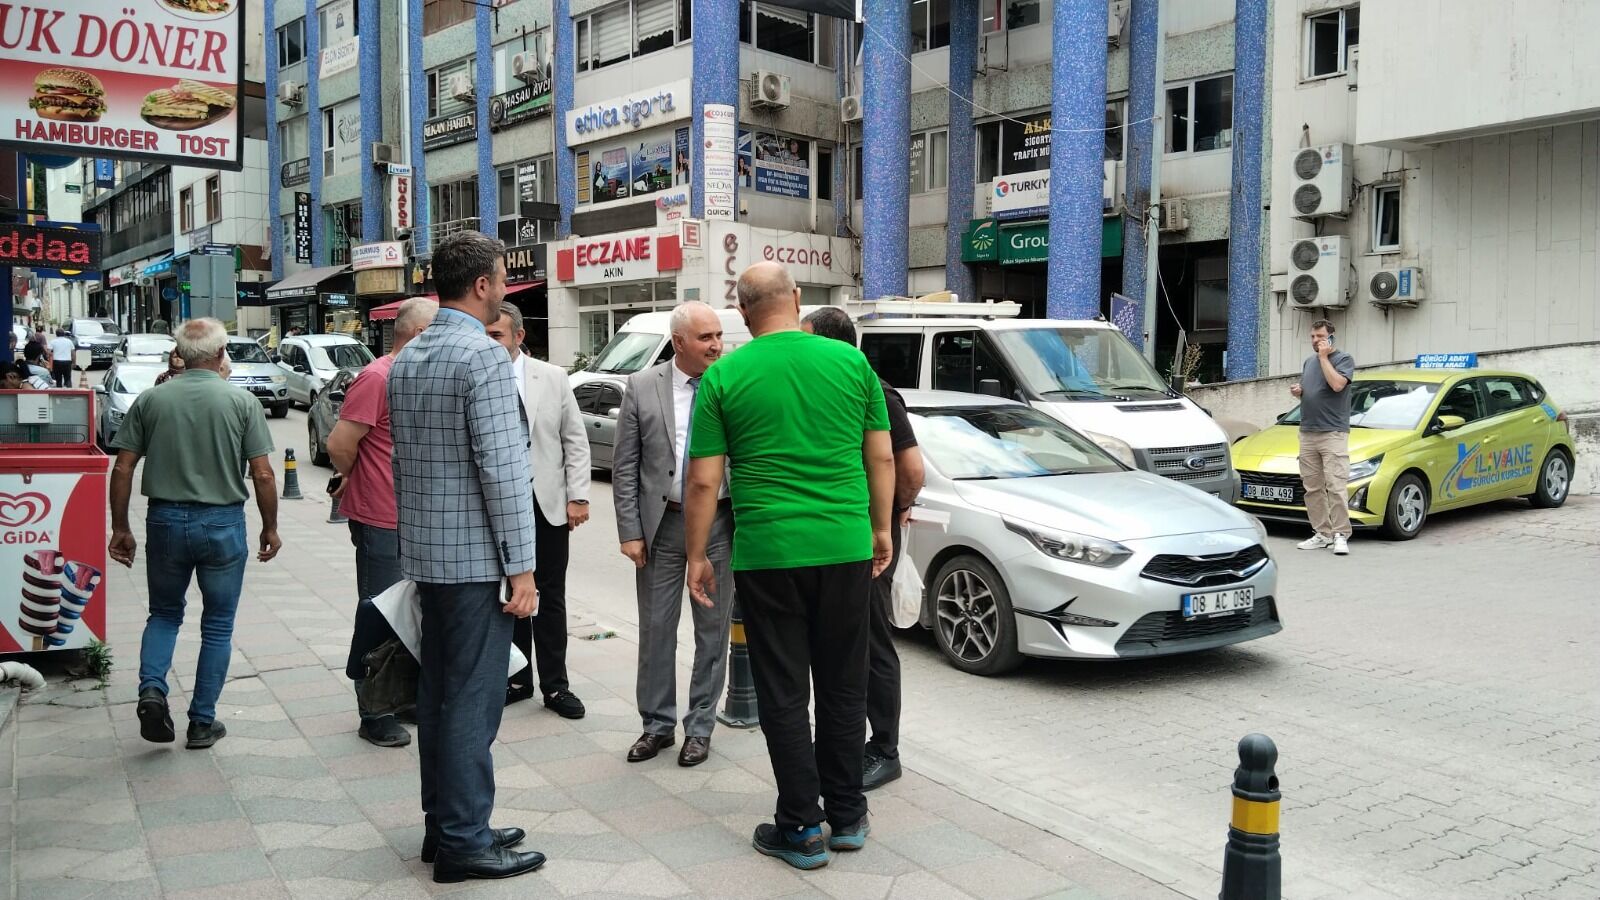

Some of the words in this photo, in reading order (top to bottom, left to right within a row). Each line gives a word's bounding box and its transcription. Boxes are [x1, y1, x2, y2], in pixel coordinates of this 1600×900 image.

[72, 8, 229, 74] DÖNER
[505, 88, 530, 109] HASAN
[575, 106, 620, 135] ethica
[622, 89, 676, 128] sigorta
[16, 119, 159, 151] HAMBURGER
[176, 133, 230, 157] TOST
[1013, 148, 1039, 161] TRAFİK
[686, 226, 697, 244] E
[506, 249, 534, 269] HAL
[577, 236, 651, 266] ECZANE
[764, 245, 832, 268] eczane
[604, 267, 623, 279] AKIN
[1420, 354, 1448, 362] SÜRÜCÜ
[1472, 470, 1500, 487] SÜRÜCÜ
[1501, 464, 1533, 481] KURSLARI
[1260, 486, 1274, 497] ABS
[1278, 488, 1292, 498] 492
[0, 530, 51, 545] GiDA
[1192, 595, 1206, 613] 08
[1215, 593, 1228, 610] AC
[1233, 589, 1251, 607] 098
